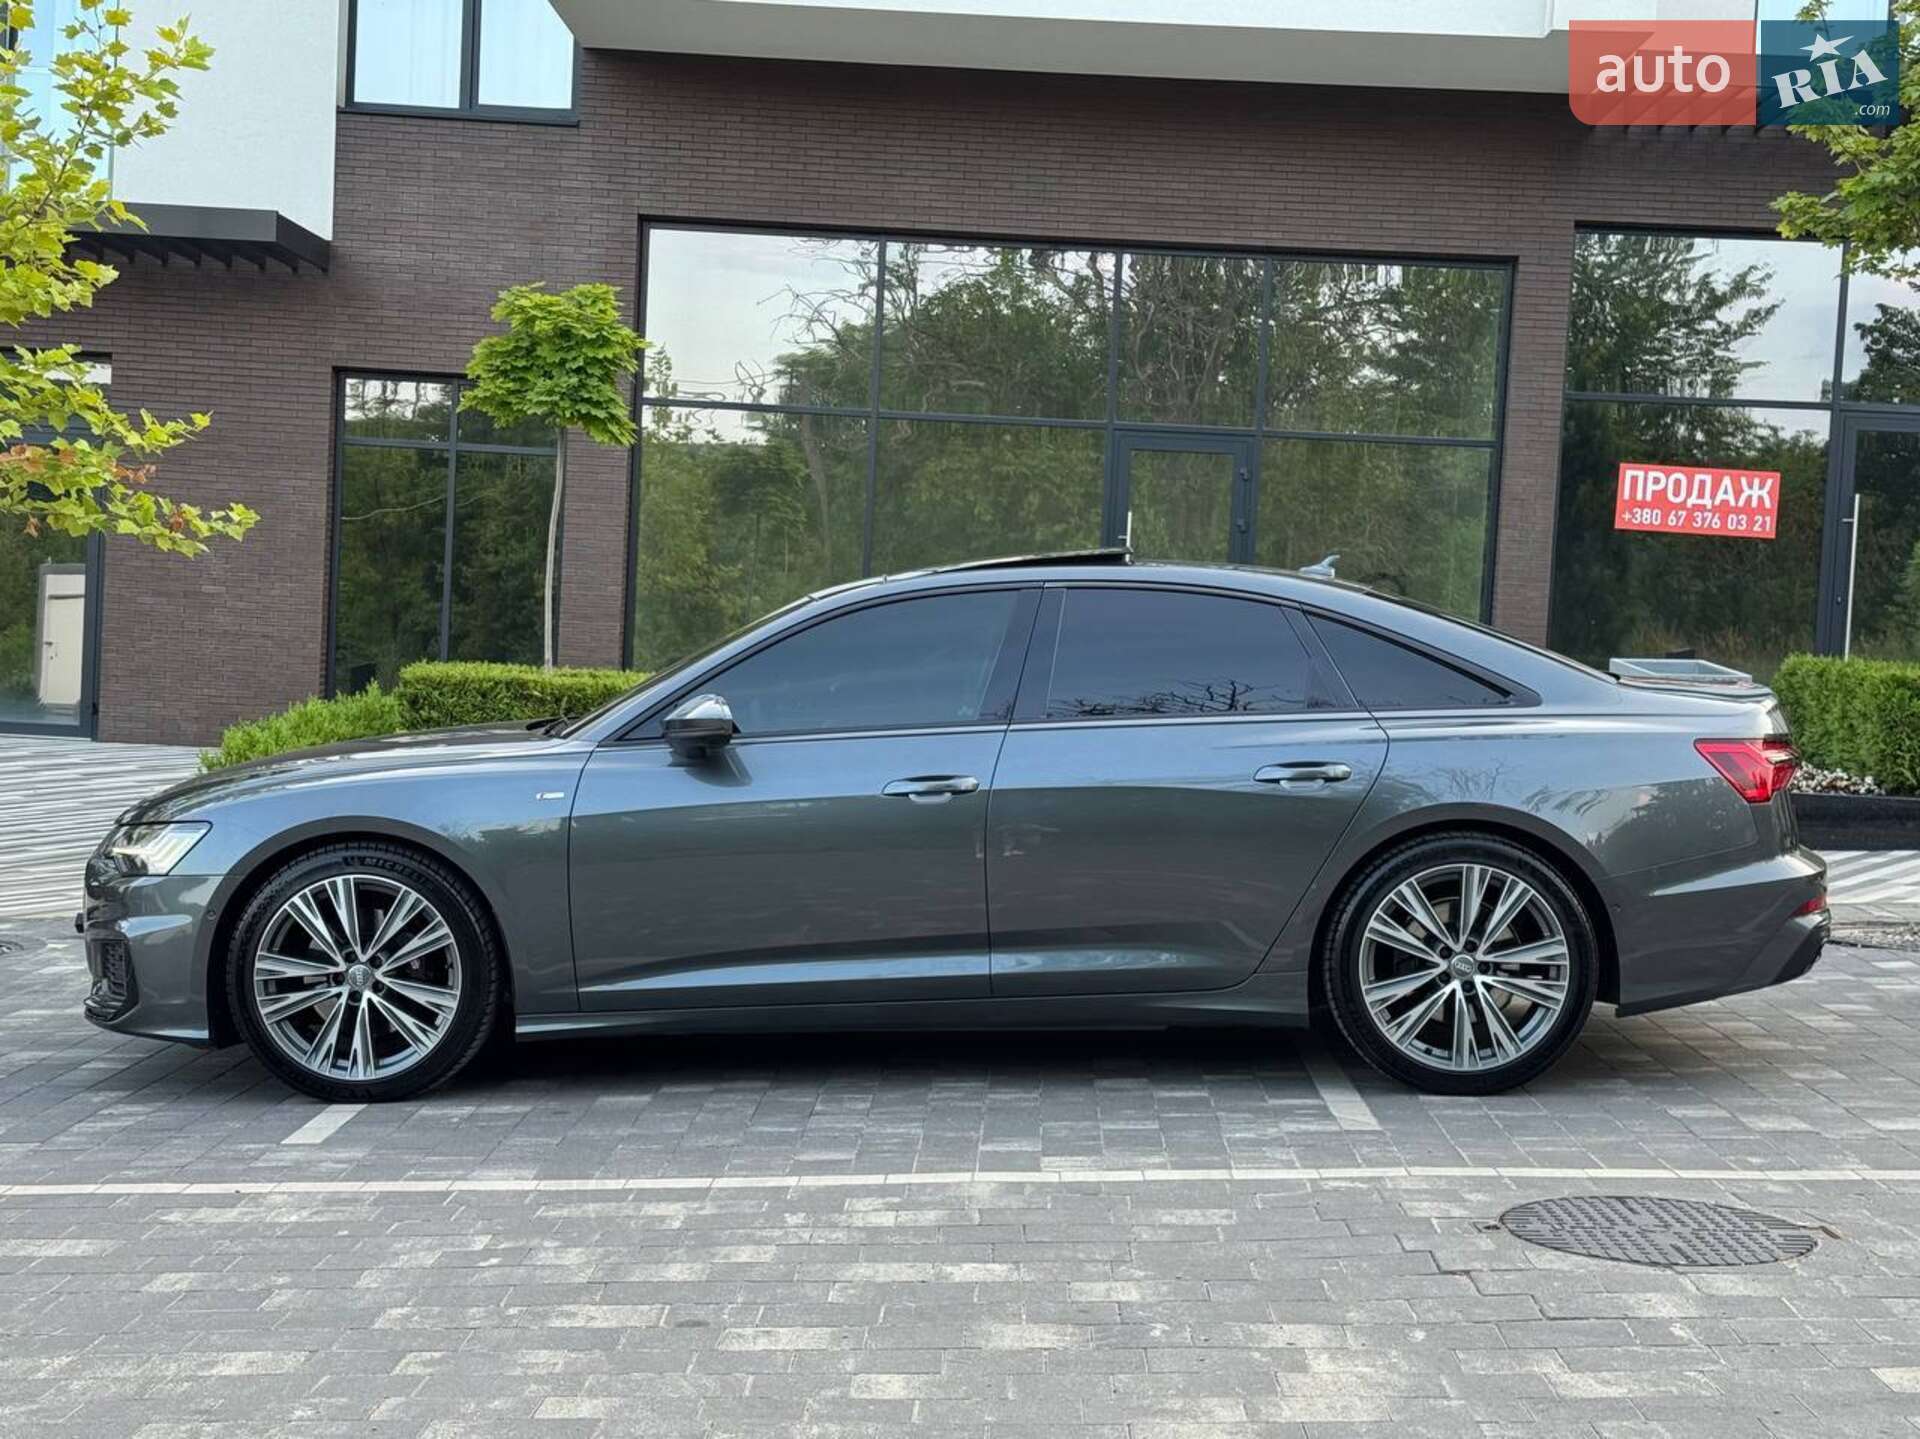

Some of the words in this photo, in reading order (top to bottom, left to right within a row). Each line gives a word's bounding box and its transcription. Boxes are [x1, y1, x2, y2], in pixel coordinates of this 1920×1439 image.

[1623, 469, 1774, 509] ПРОДАЖ
[1622, 507, 1662, 525] +380
[1667, 510, 1686, 527] 67
[1692, 512, 1720, 529] 376
[1727, 514, 1747, 530] 03
[1753, 515, 1771, 532] 21
